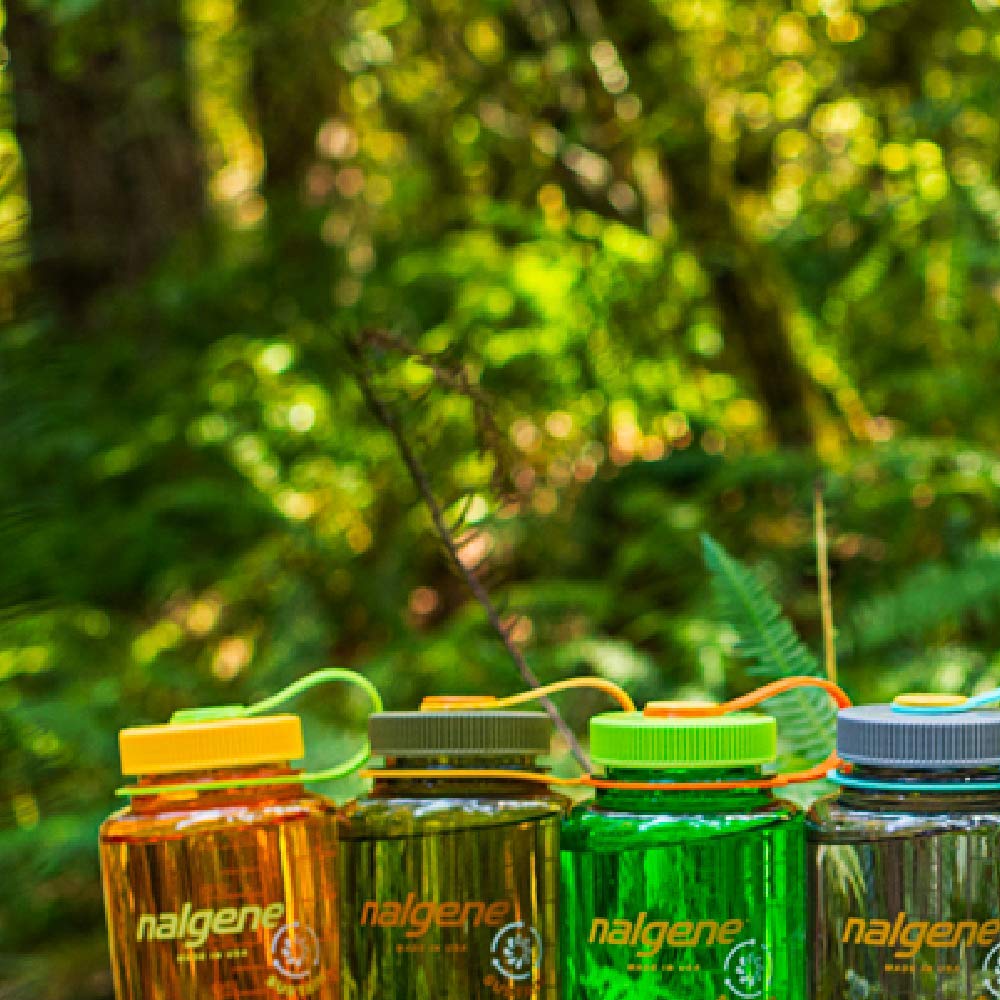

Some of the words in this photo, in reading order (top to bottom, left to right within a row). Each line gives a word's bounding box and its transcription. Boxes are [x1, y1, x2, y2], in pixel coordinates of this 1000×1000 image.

[136, 902, 285, 948] nalgene
[360, 892, 512, 938] nalgene
[588, 911, 745, 957] nalgene
[842, 912, 1000, 959] nalgene
